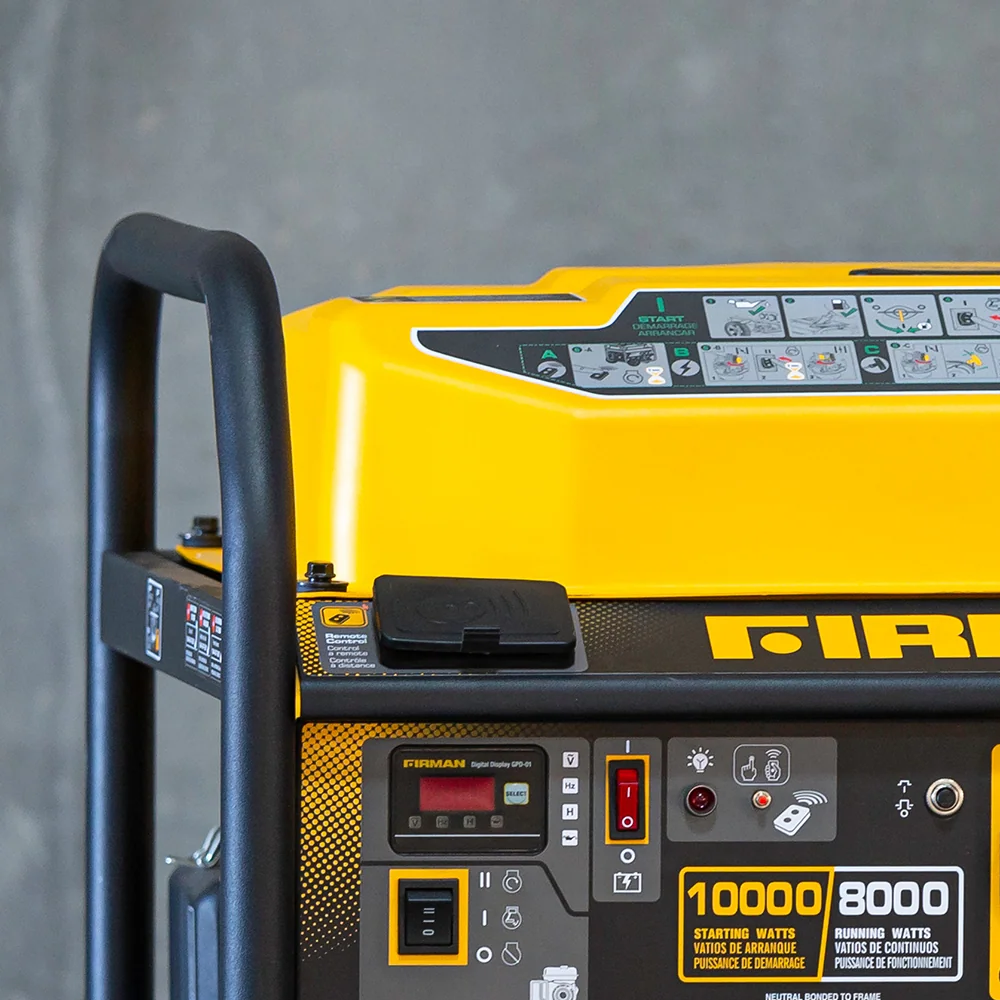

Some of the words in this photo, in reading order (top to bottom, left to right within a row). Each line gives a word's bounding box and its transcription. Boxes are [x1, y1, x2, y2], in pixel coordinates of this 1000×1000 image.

[541, 350, 557, 359] A
[674, 348, 689, 356] B
[864, 346, 880, 354] C
[403, 759, 465, 768] FIRMAN
[567, 808, 574, 816] H
[687, 881, 822, 916] 10000
[838, 881, 949, 915] 8000
[694, 928, 749, 939] STARTING
[756, 928, 795, 939] WATTS
[835, 928, 885, 939] RUNNING
[892, 928, 931, 939] WATTS
[694, 942, 727, 954] VATIOS
[730, 942, 742, 954] DE
[745, 942, 796, 954] ARRANQUE
[835, 942, 867, 953] VATIOS
[870, 942, 882, 953] DE
[885, 942, 938, 953] CONTINUOS
[694, 957, 739, 969] PUISSANCE
[741, 957, 752, 969] DE
[755, 957, 805, 969] DEMARRAGE
[835, 957, 873, 969] PUISSANCE
[876, 957, 886, 969] DE
[888, 957, 952, 969] FONCTIONNEMENT
[765, 993, 802, 1000] NEUTRAL
[805, 993, 838, 1000] BONDED
[840, 993, 851, 1000] TO
[853, 993, 881, 1000] FRAME
